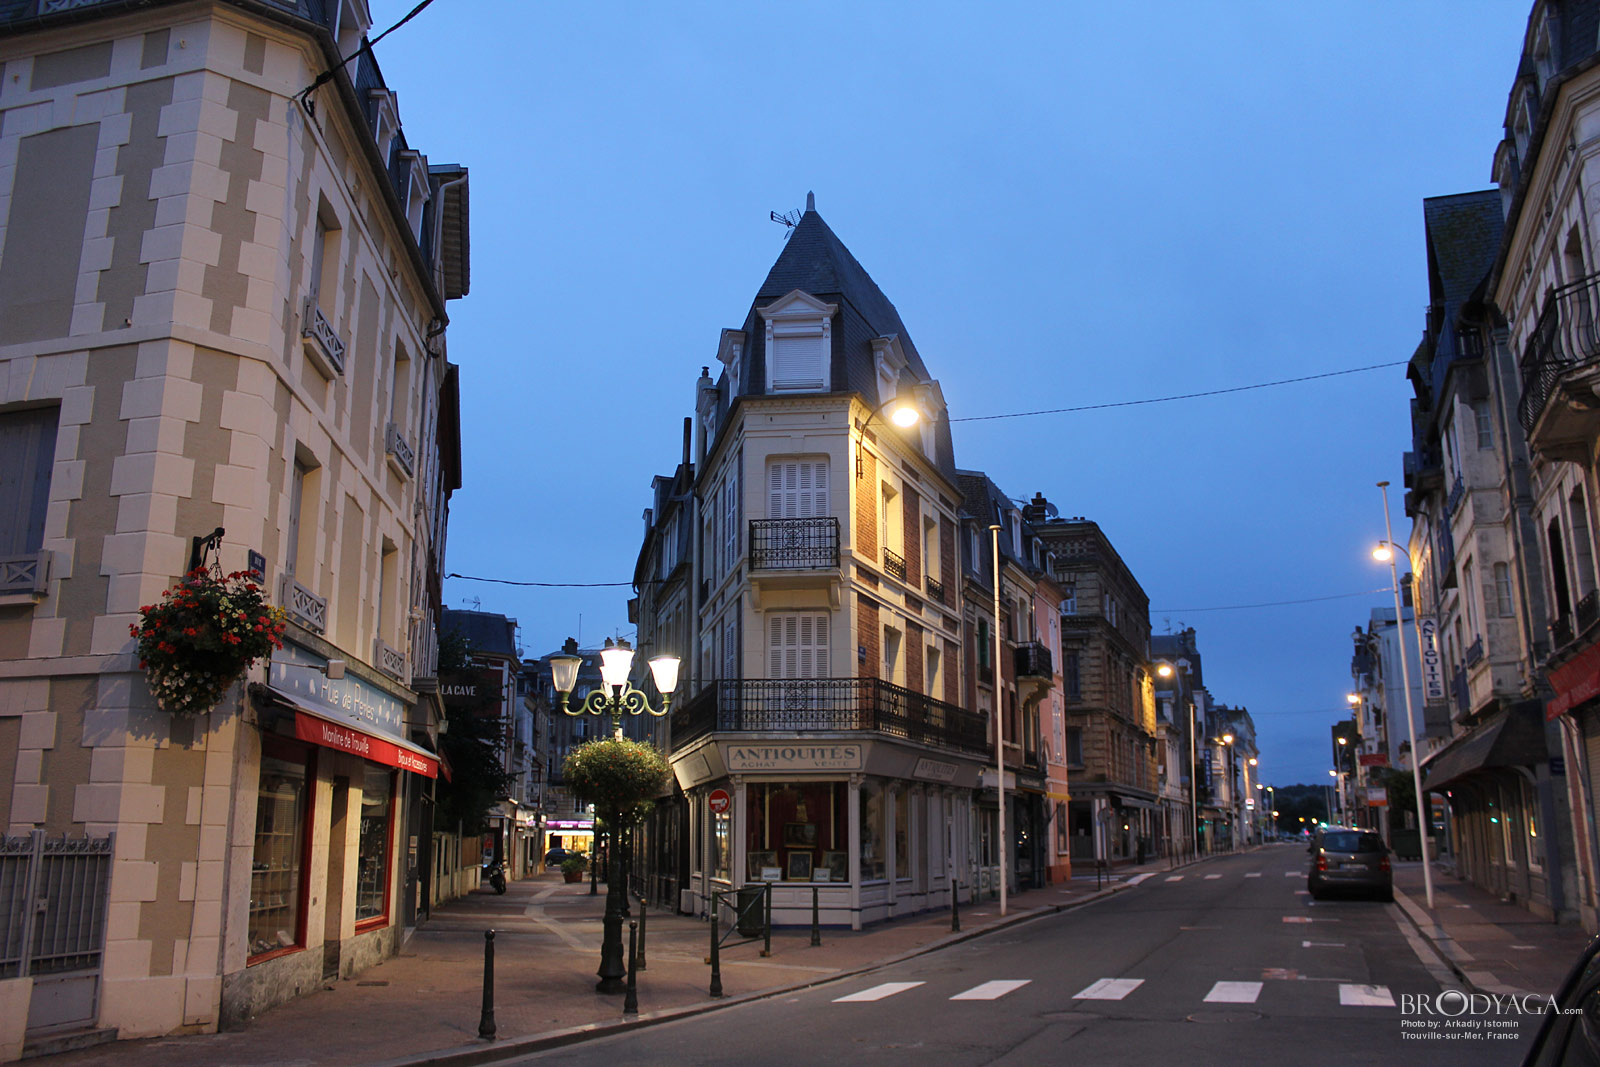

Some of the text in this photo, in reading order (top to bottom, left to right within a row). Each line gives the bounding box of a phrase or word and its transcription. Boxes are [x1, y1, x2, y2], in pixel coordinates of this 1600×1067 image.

[1422, 620, 1442, 697] ANTIQUITES
[342, 679, 351, 710] de
[354, 683, 374, 720] Perles
[441, 684, 477, 696] LA CAVE
[733, 746, 856, 762] ANTIQUITÉS
